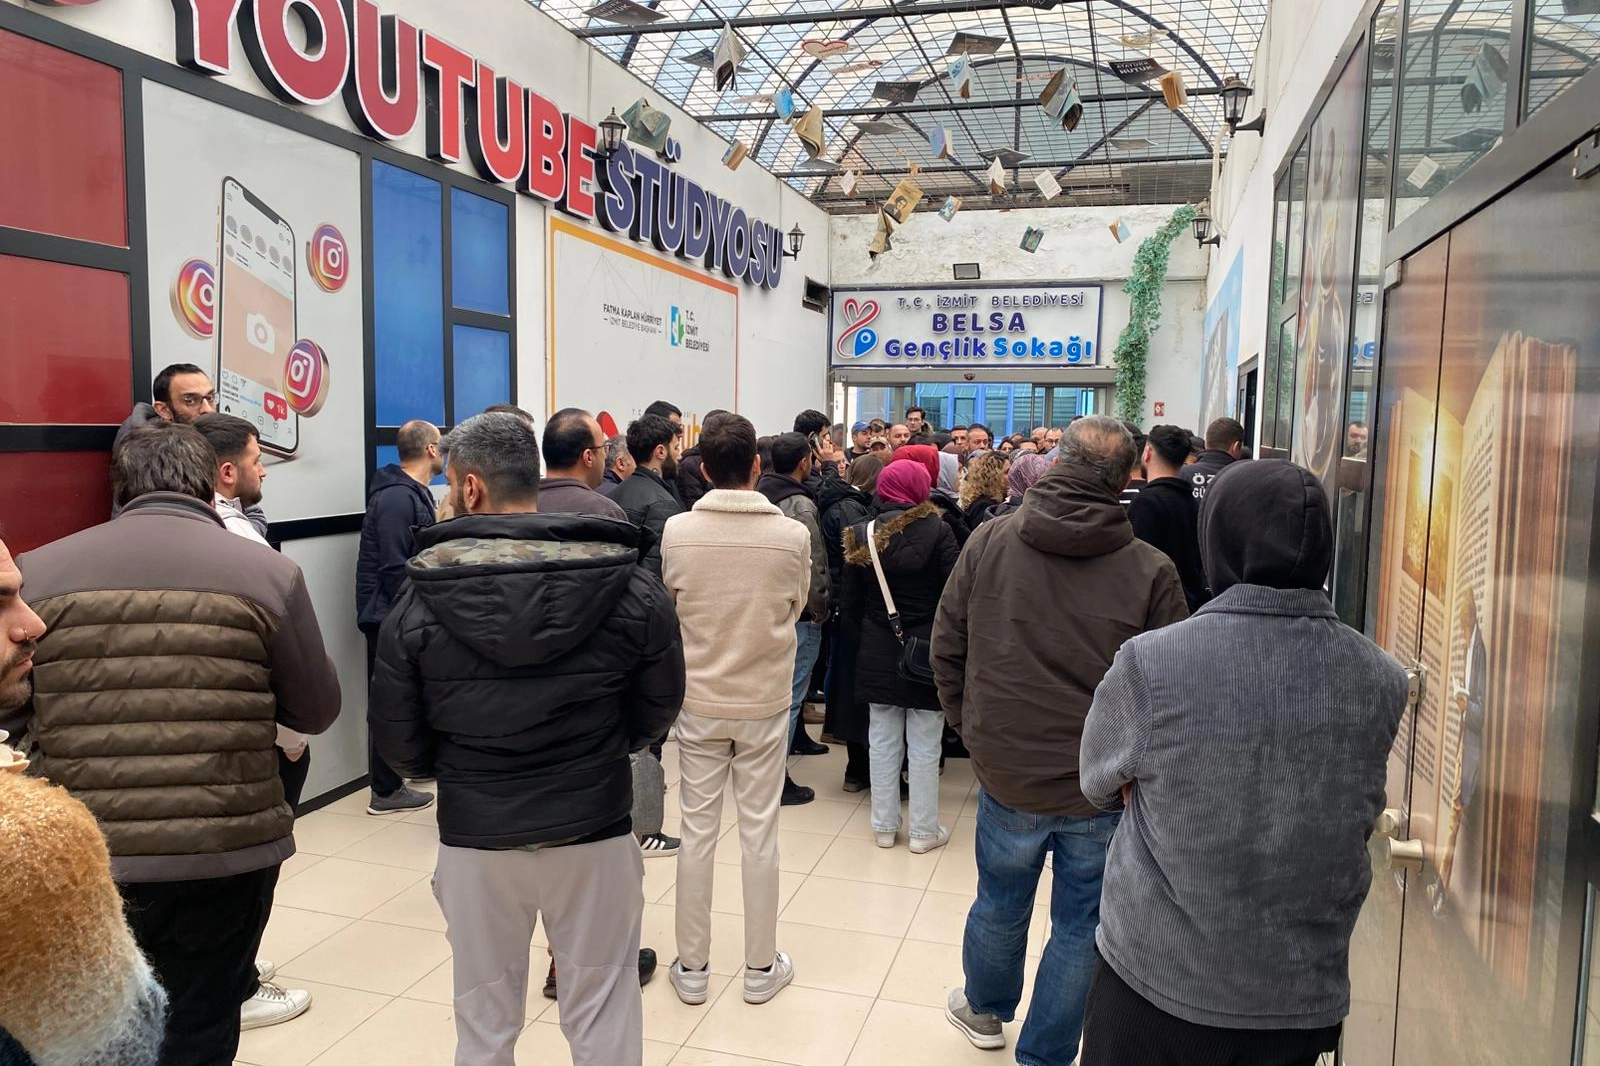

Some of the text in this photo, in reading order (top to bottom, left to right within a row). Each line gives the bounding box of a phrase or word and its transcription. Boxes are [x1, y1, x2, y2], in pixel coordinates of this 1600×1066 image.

[603, 137, 784, 289] STÜDYOSU
[937, 294, 977, 307] İZMİT
[991, 292, 1085, 307] BELEDİYESİ
[603, 303, 620, 316] FATMA
[621, 308, 641, 320] KAPLAN
[931, 312, 1026, 332] BELSA
[885, 335, 1092, 362] Gençlik Sokağı
